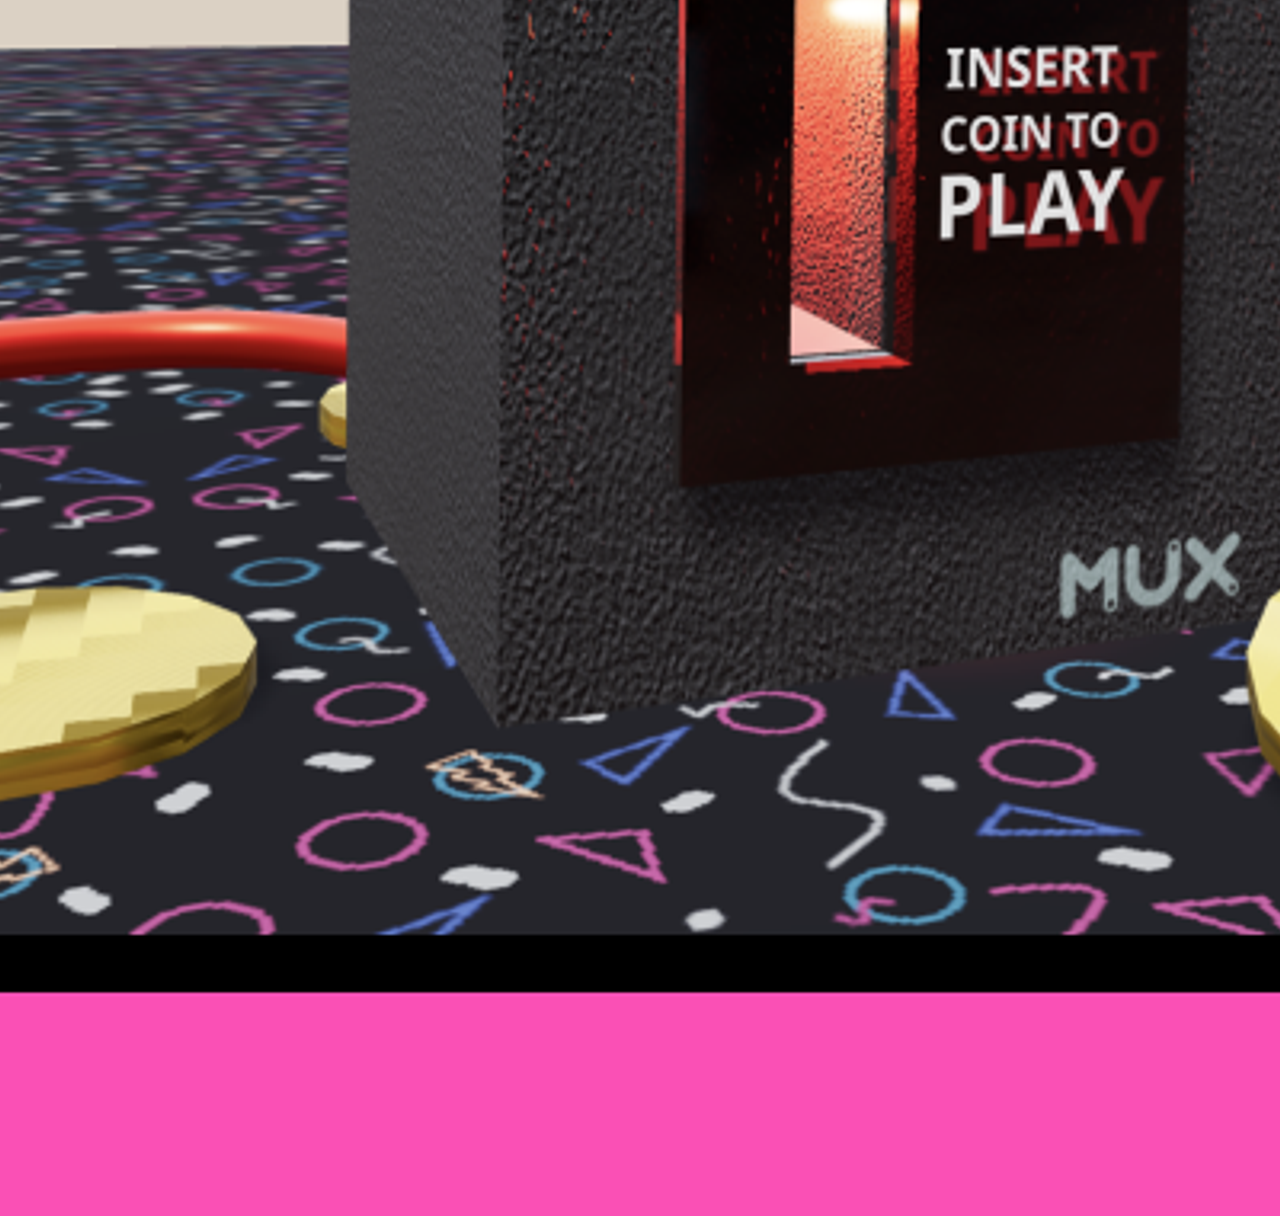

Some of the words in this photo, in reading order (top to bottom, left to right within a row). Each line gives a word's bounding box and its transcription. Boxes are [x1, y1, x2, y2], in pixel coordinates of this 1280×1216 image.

[945, 44, 1119, 90] INSERT
[940, 113, 1052, 154] COIN
[1065, 111, 1121, 150] TO
[939, 167, 1125, 241] PLAY
[1059, 532, 1241, 620] MUX
